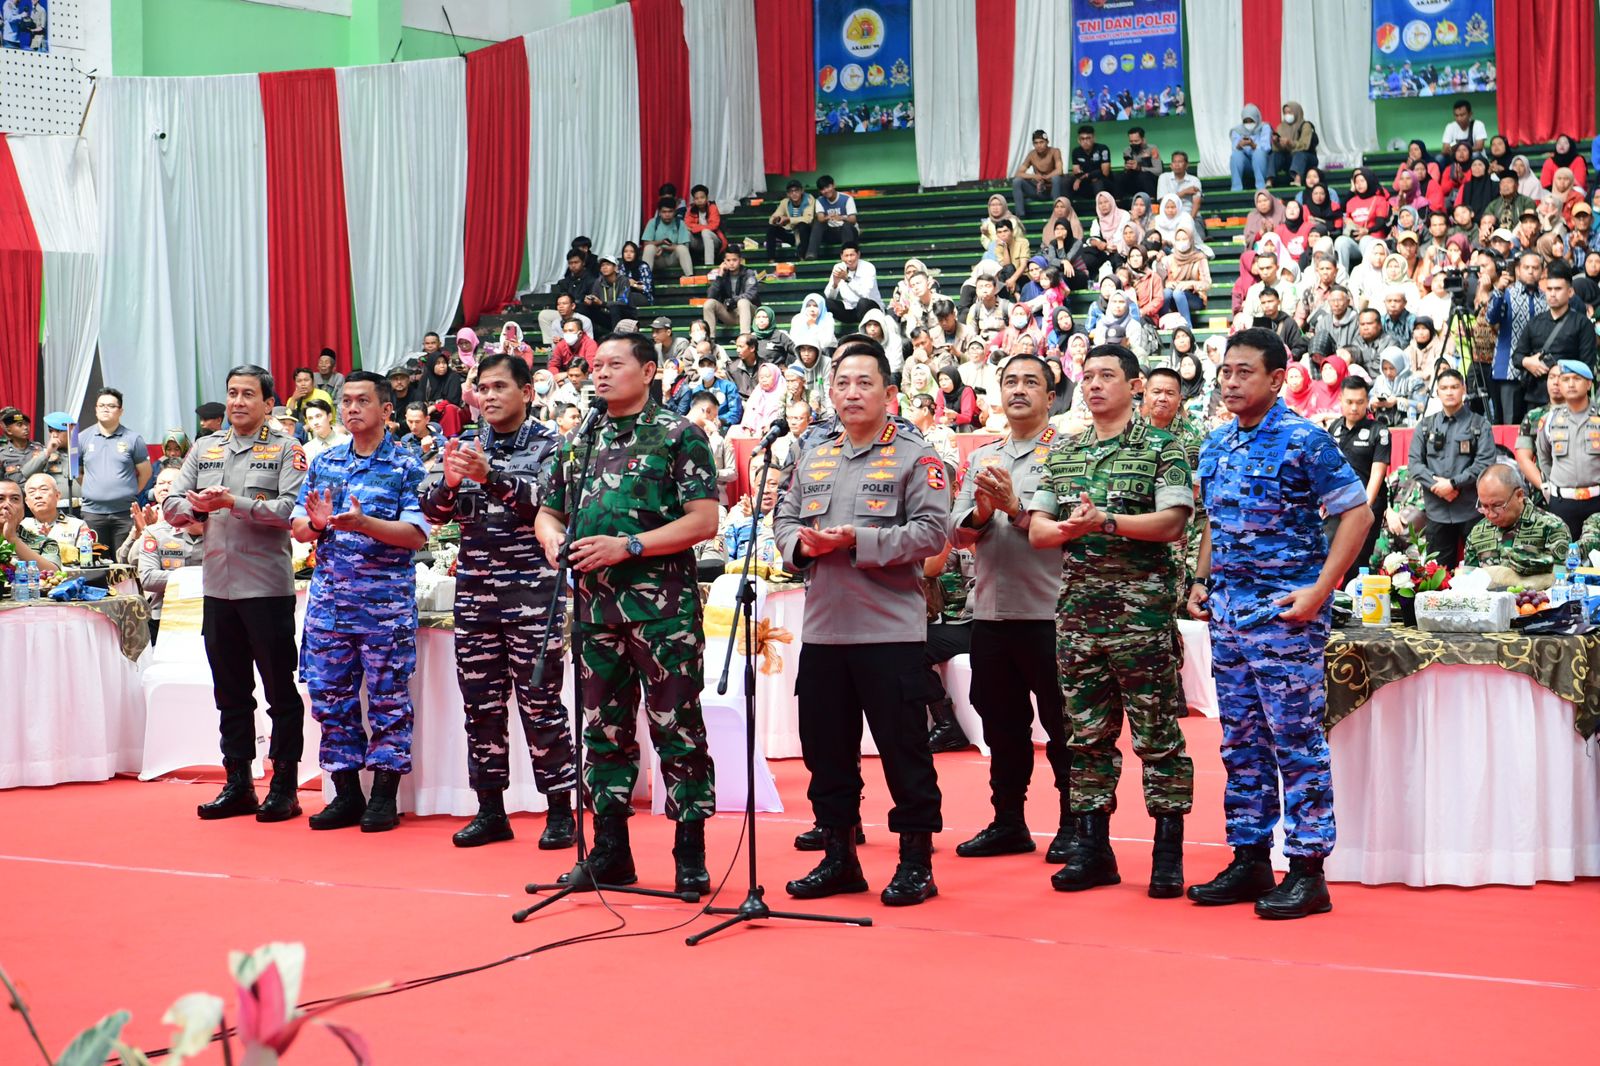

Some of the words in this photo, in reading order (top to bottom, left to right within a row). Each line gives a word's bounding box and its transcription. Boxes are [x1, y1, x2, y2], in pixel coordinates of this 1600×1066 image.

[1078, 20, 1102, 33] TNI
[1104, 17, 1133, 31] DAN
[1135, 12, 1177, 28] POLRI
[199, 461, 224, 470] DOFIRI
[250, 462, 278, 470] POLRI
[507, 463, 520, 471] TNI
[523, 463, 534, 471] AL
[1052, 465, 1084, 475] UHARYANTO
[1121, 463, 1133, 471] TNI
[1136, 463, 1148, 472] AD
[862, 483, 894, 493] POLRI
